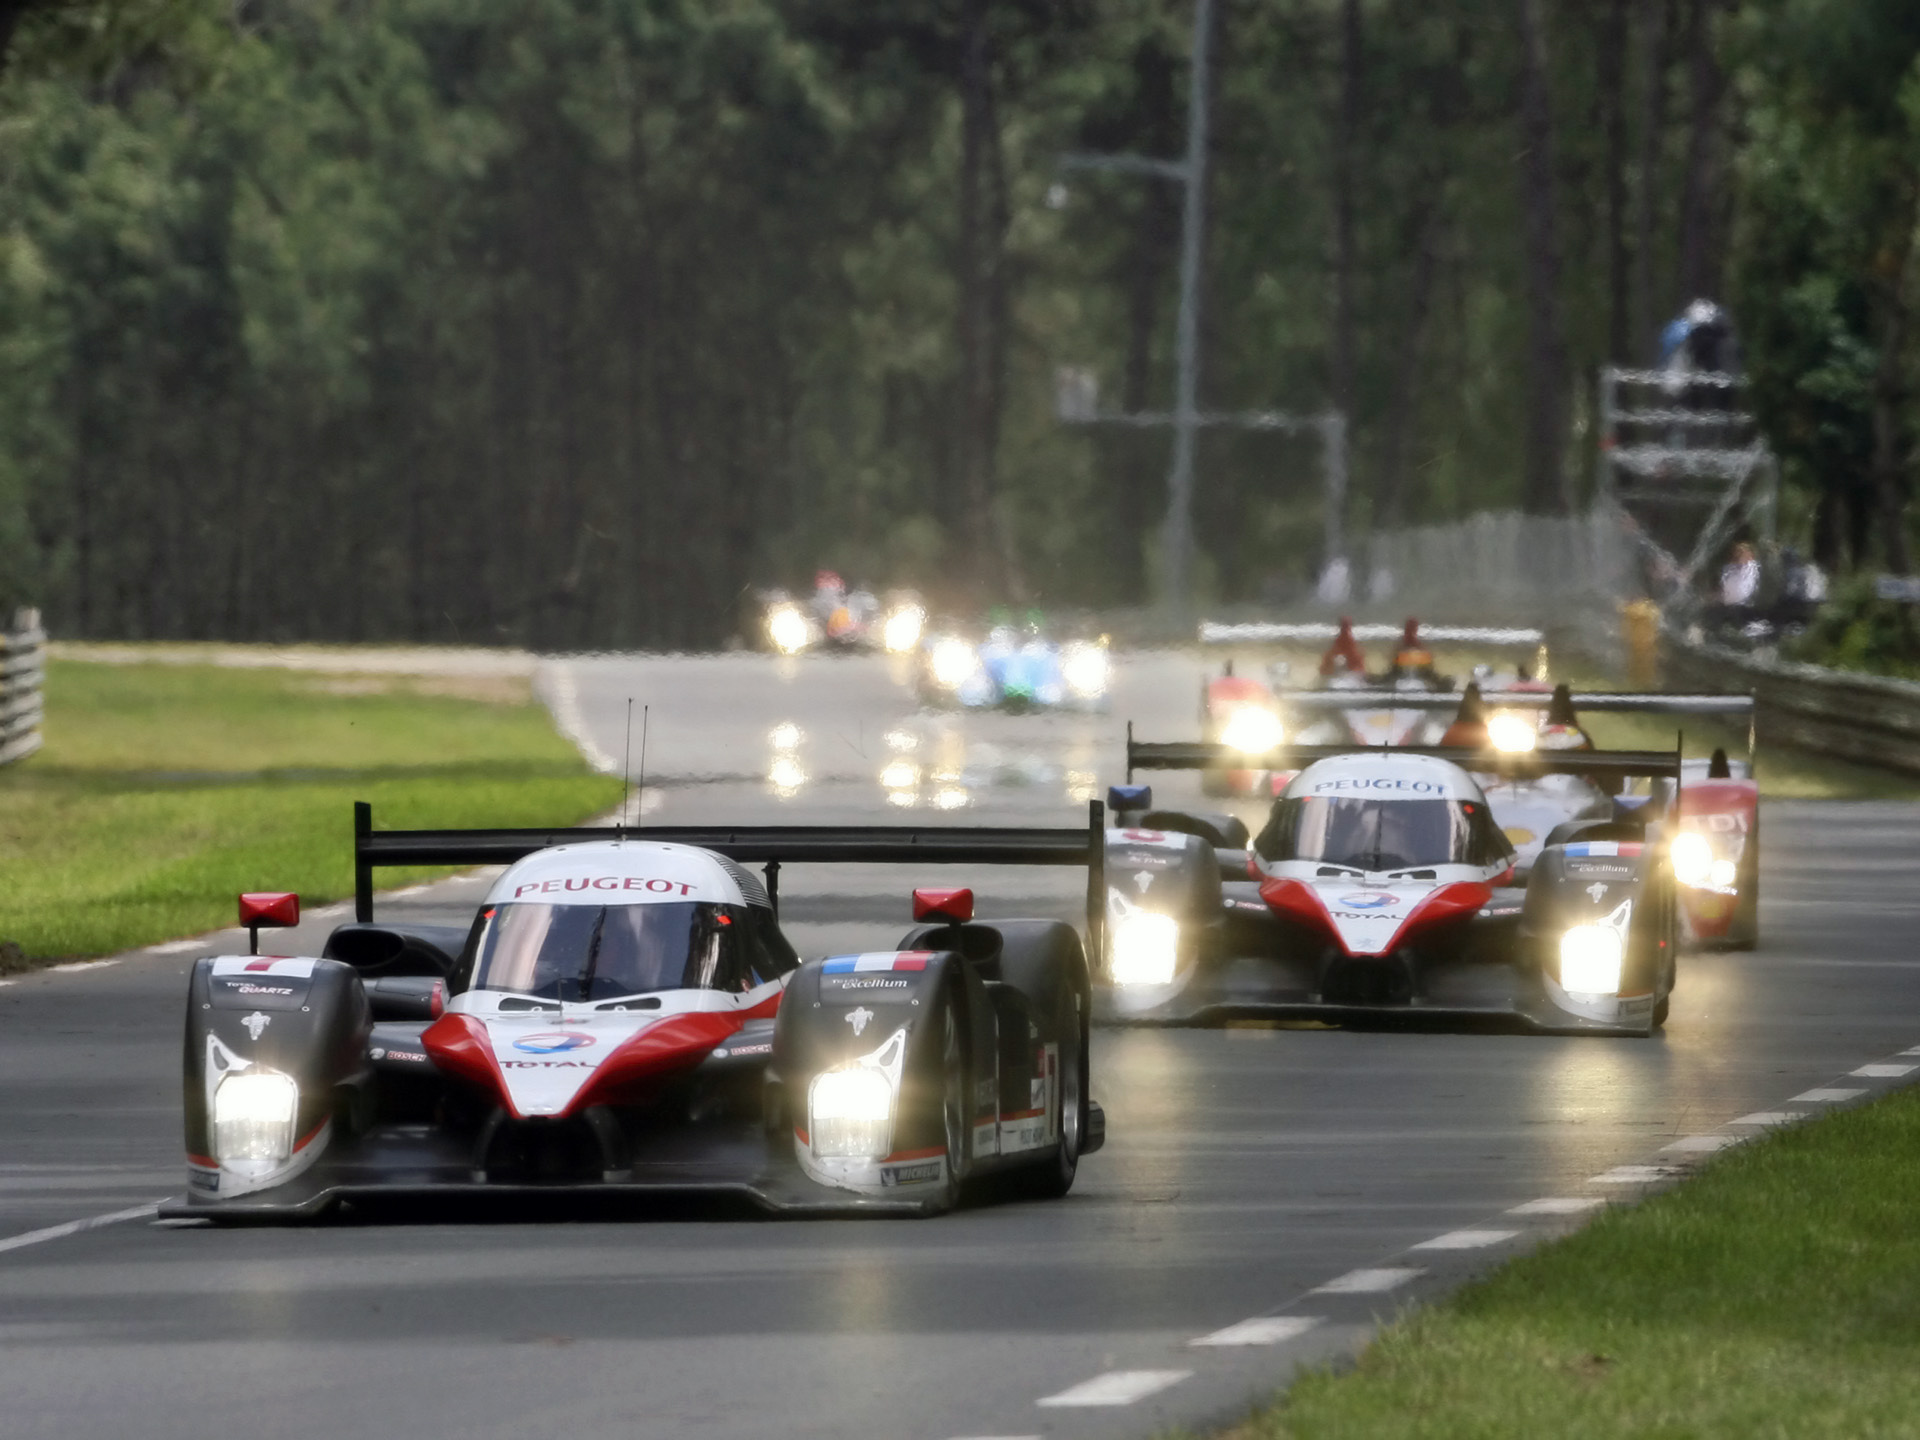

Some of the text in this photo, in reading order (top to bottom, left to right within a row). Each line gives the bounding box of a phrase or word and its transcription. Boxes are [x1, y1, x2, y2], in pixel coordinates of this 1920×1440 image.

[1314, 778, 1446, 796] PEUGEOT
[514, 876, 698, 899] PEUGEOT
[1329, 911, 1405, 920] TOTAL
[238, 986, 293, 995] QUARTZ
[499, 1060, 599, 1069] TOTAL
